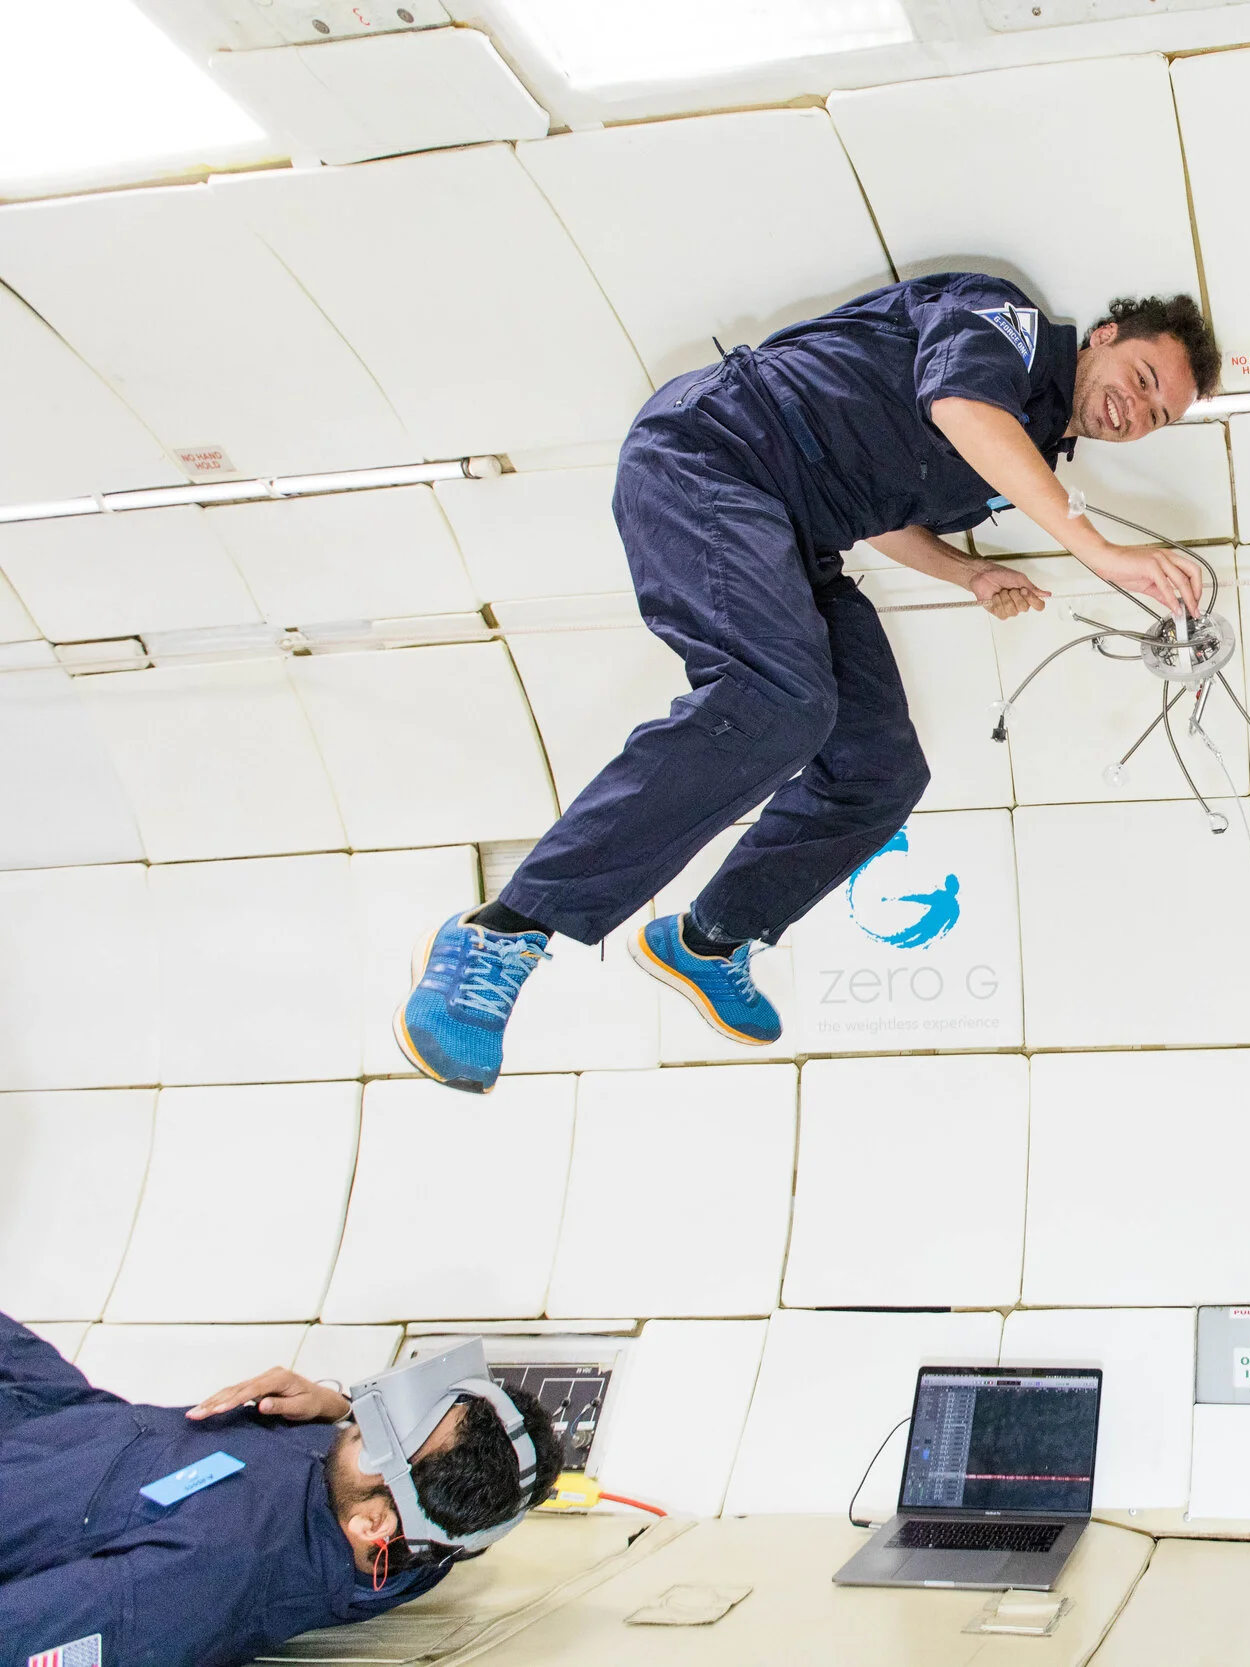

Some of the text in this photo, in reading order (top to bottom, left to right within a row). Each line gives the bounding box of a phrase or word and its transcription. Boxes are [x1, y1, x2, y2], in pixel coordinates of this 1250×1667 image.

[993, 315, 1029, 357] G-FORCE ONE
[1231, 356, 1247, 366] NO
[181, 451, 223, 462] NO HAND
[818, 964, 999, 1004] zero G
[818, 1014, 1000, 1035] the weightless experience
